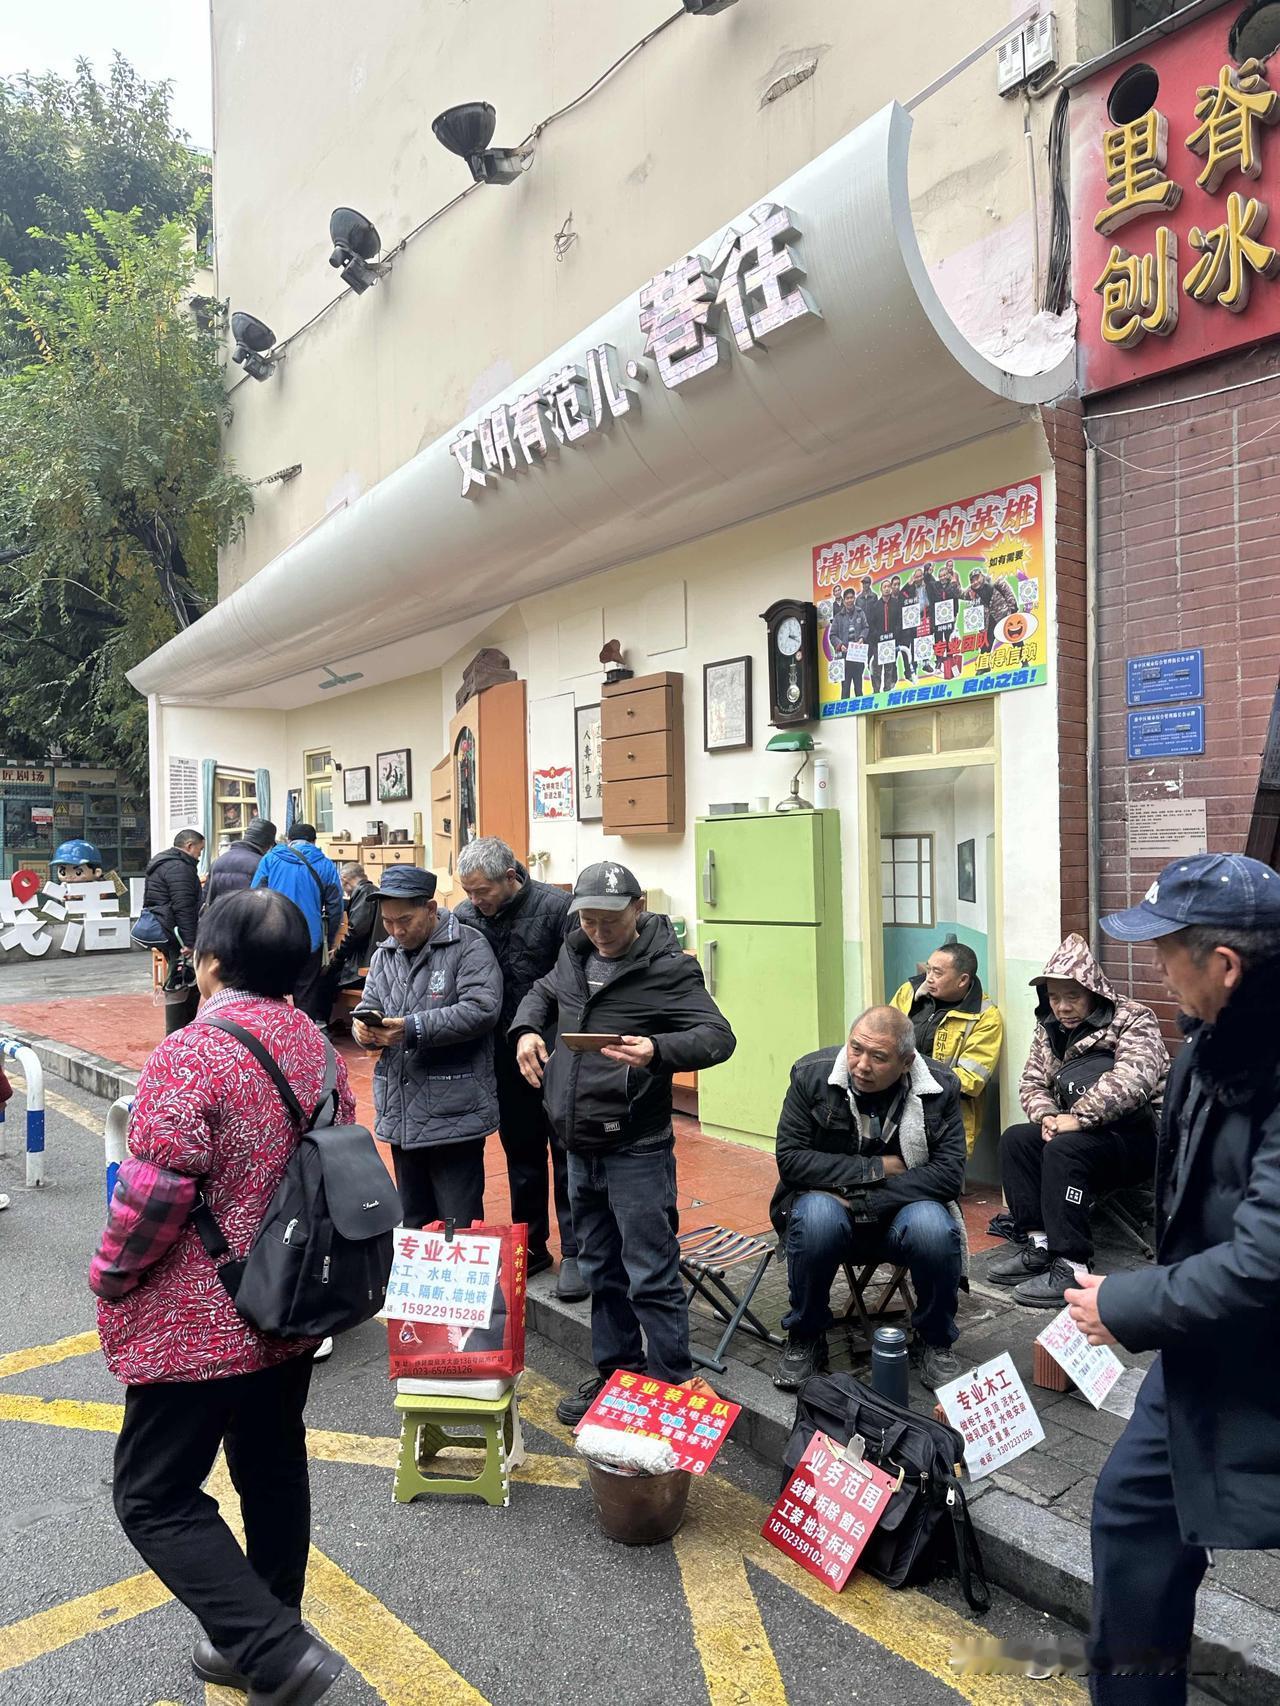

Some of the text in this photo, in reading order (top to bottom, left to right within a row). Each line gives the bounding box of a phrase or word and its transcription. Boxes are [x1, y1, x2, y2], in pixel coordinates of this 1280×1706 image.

[1094, 58, 1279, 236] 里脊
[1094, 193, 1277, 346] 刨冰
[817, 491, 1037, 586] 请选择你的英雄
[989, 548, 1024, 567] 如有需要
[933, 631, 990, 657] 专业团队
[974, 643, 1038, 670] 值得信赖
[397, 1235, 490, 1265] 专业木工
[401, 1302, 486, 1322] 15922915286
[608, 1385, 726, 1429] 泥水工 木工 水电安装
[619, 1373, 731, 1419] 专业装修队
[956, 1369, 1012, 1410] 专业木工
[960, 1412, 982, 1432] 做柜子
[1001, 1389, 1021, 1408] 泥水工
[965, 1402, 1027, 1444] 做乳胶漆 水电安装
[987, 1425, 1017, 1447] 质量第一
[805, 1449, 883, 1514] 业务范围
[790, 1477, 866, 1541] 线槽 拆除 窗台
[778, 1498, 855, 1565] 工装 地沟 拆墙
